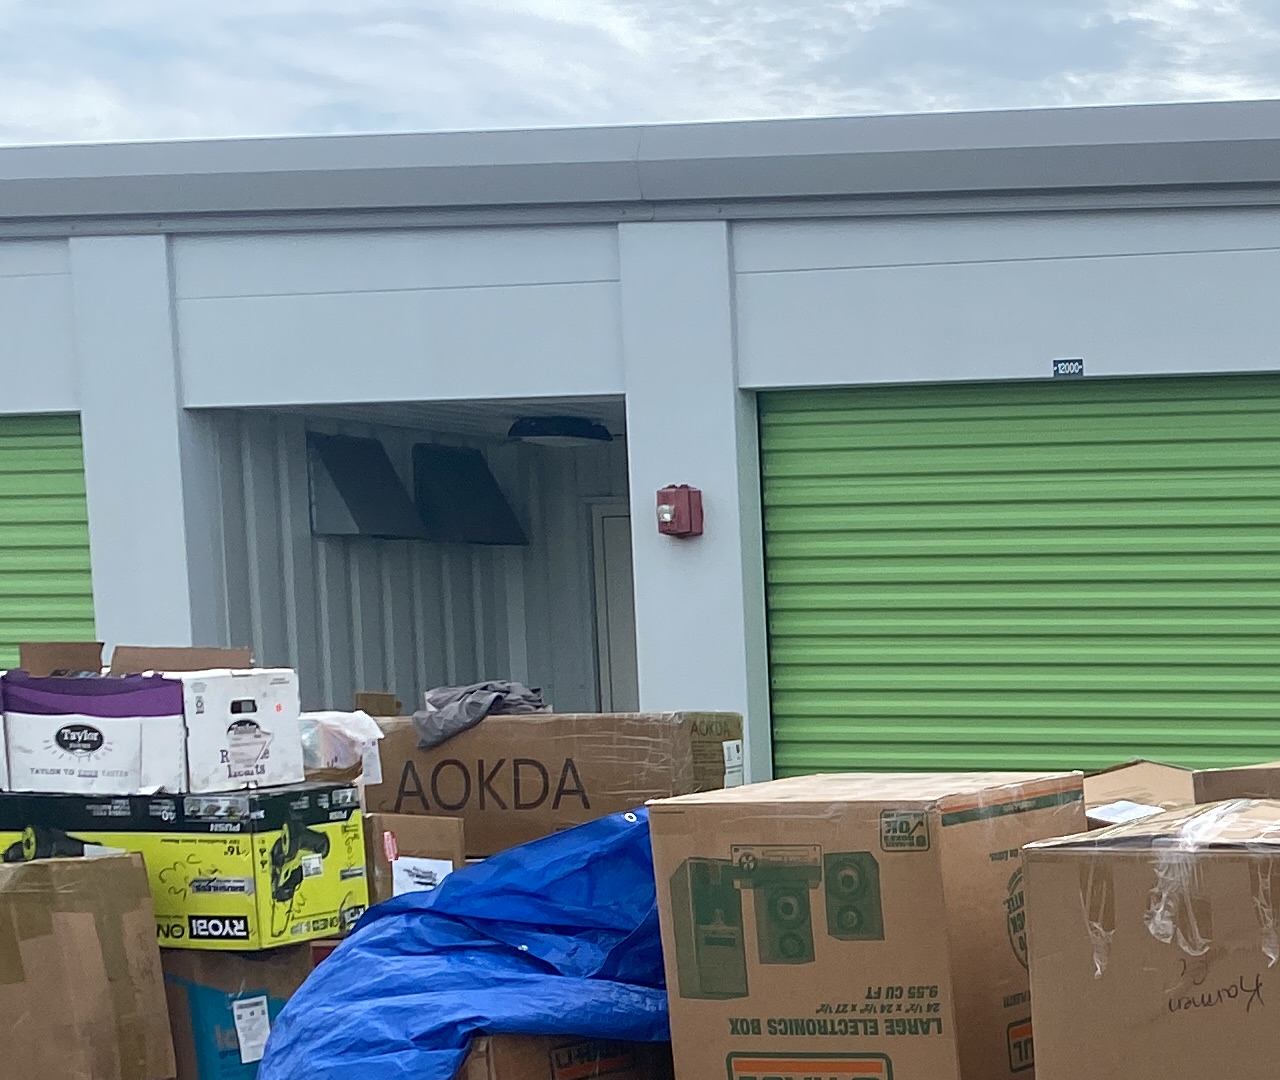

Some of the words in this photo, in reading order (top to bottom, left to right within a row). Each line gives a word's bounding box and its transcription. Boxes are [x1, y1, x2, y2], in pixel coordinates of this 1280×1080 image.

[61, 729, 99, 742] Taylor
[394, 758, 590, 813] AOKDA
[210, 823, 240, 831] PUSH
[192, 919, 247, 936] RYOBI
[865, 985, 881, 999] FT
[885, 985, 904, 999] CU
[908, 985, 939, 999] 9.55
[1168, 974, 1265, 1013] Karmen
[834, 1003, 848, 1014] 27
[880, 1003, 893, 1014] 24
[927, 1003, 940, 1014] 24
[730, 1017, 763, 1035] BOX
[768, 1017, 879, 1035] ELECTRONICS
[885, 1018, 943, 1036] LARGE
